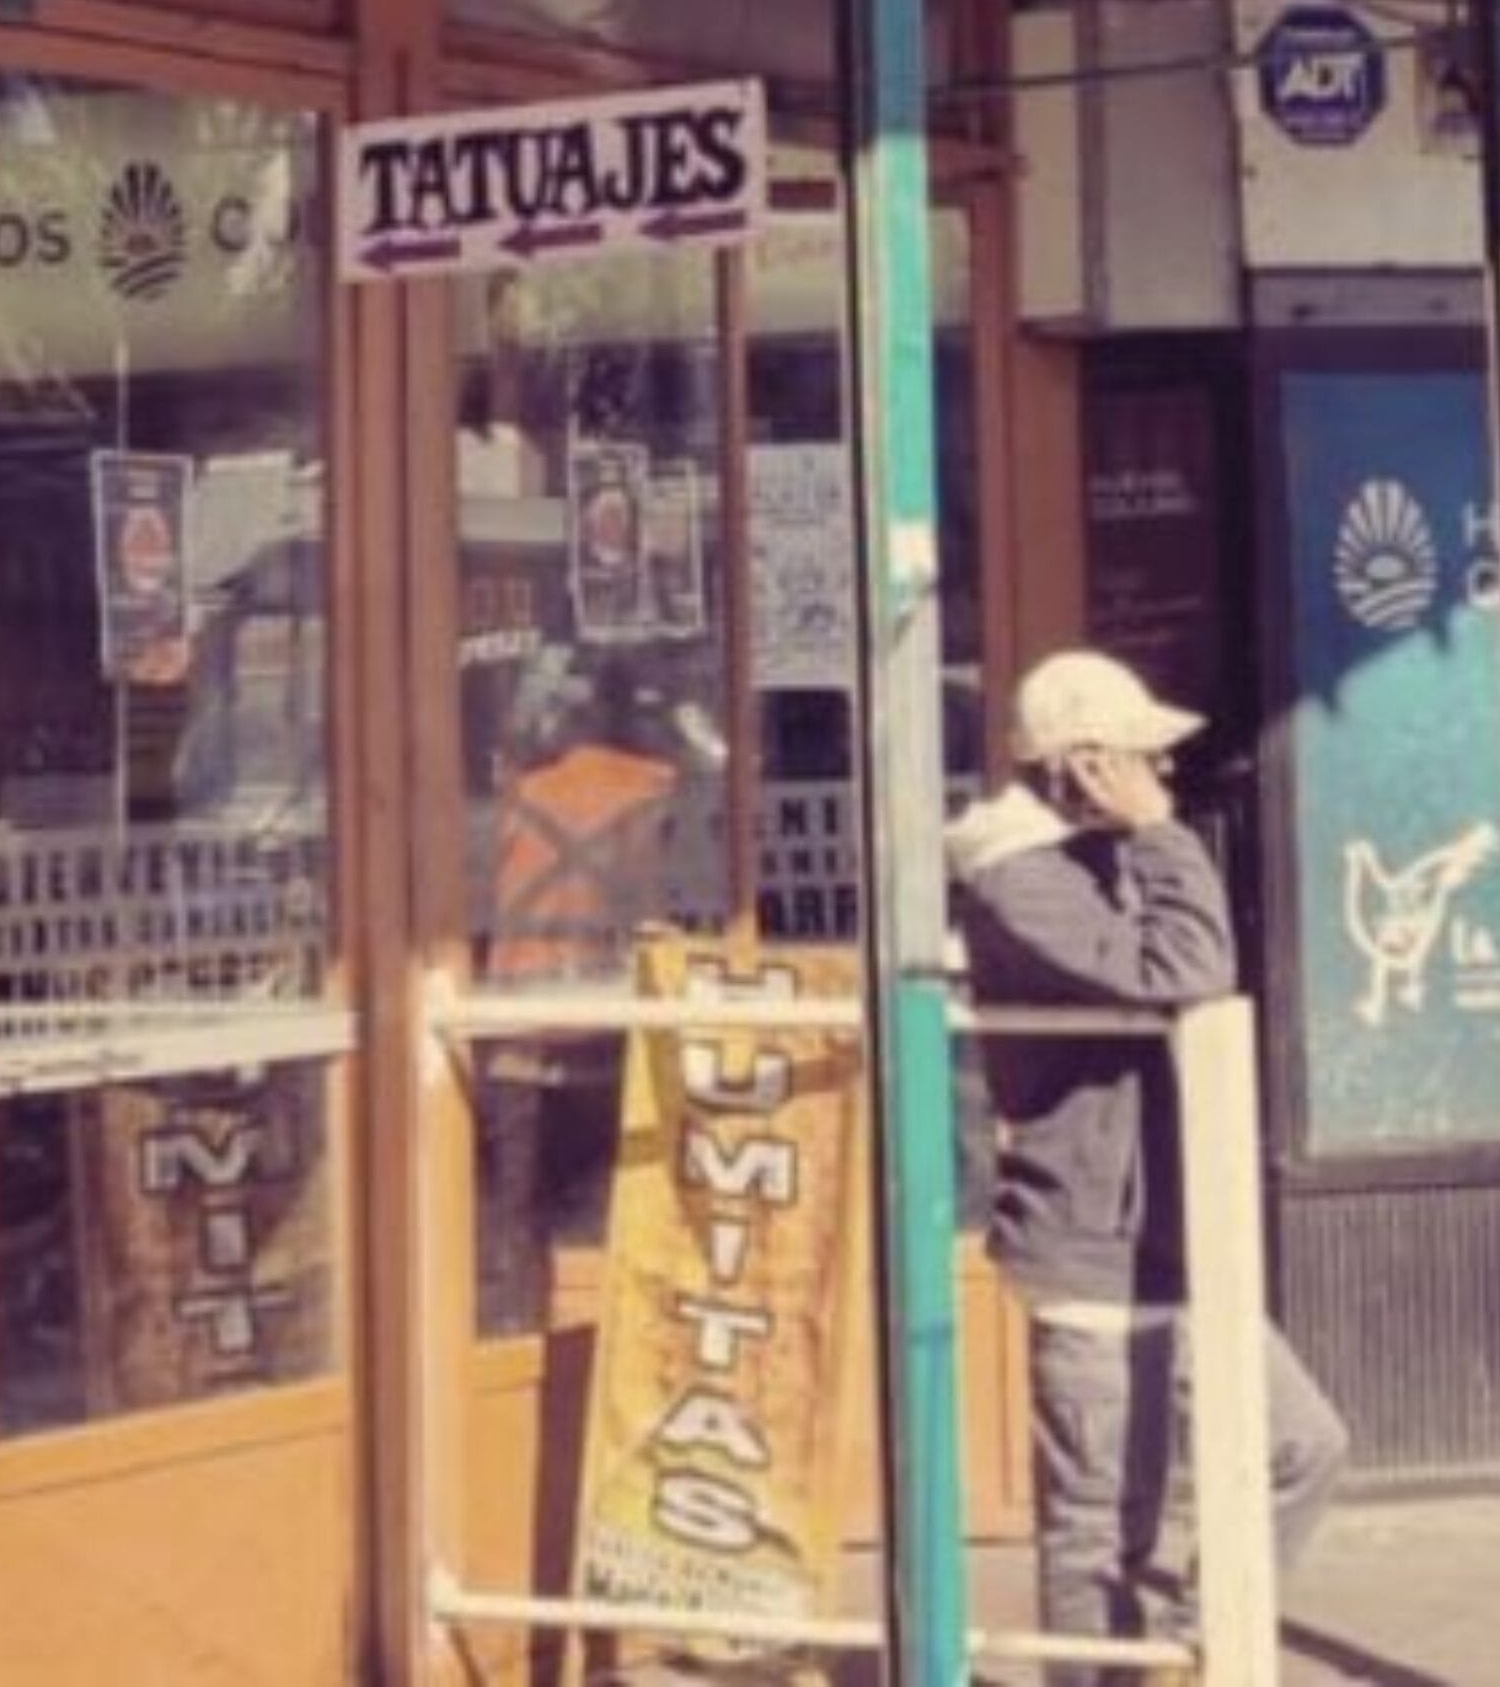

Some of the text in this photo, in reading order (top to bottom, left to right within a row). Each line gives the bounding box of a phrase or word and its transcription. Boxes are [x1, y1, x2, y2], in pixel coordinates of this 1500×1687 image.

[1276, 52, 1363, 101] ADT
[358, 106, 746, 235] TATUAJES
[654, 952, 799, 1556] HUMITAS
